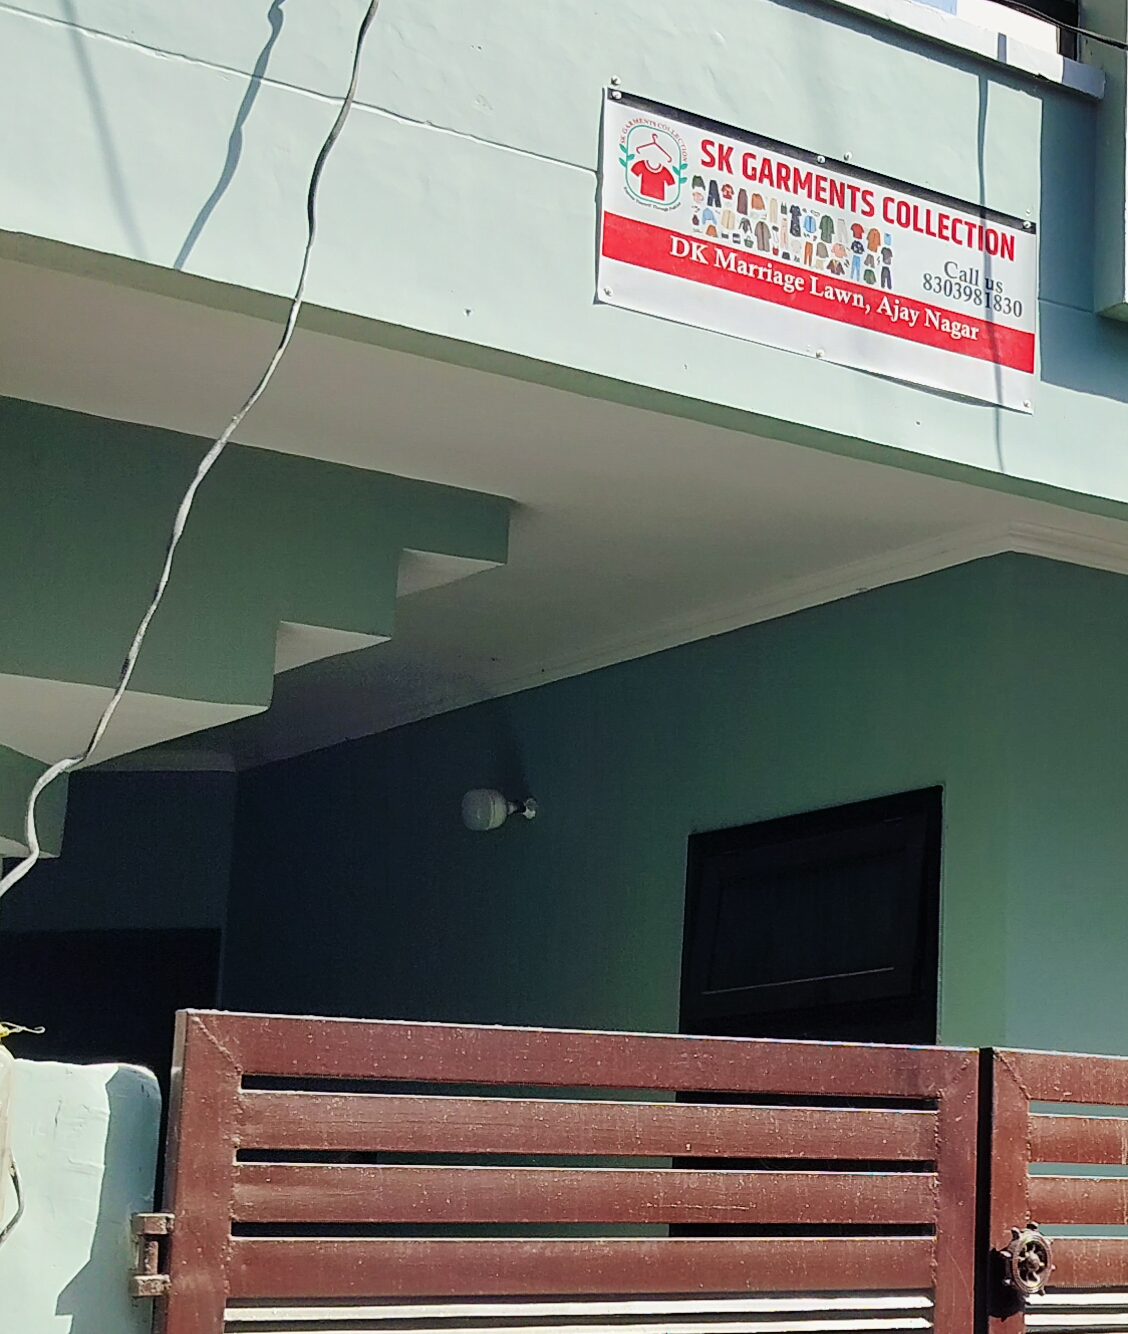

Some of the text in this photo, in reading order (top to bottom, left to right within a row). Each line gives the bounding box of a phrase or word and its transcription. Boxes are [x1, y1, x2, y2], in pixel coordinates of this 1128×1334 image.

[622, 118, 657, 134] GARMENTS
[701, 139, 1015, 262] SK GARMENTS COLLECTION
[669, 234, 980, 341] DK Marriage Lawn, Ajay Nagar
[922, 272, 1023, 318] 8303981830
[944, 260, 1004, 294] Call us
